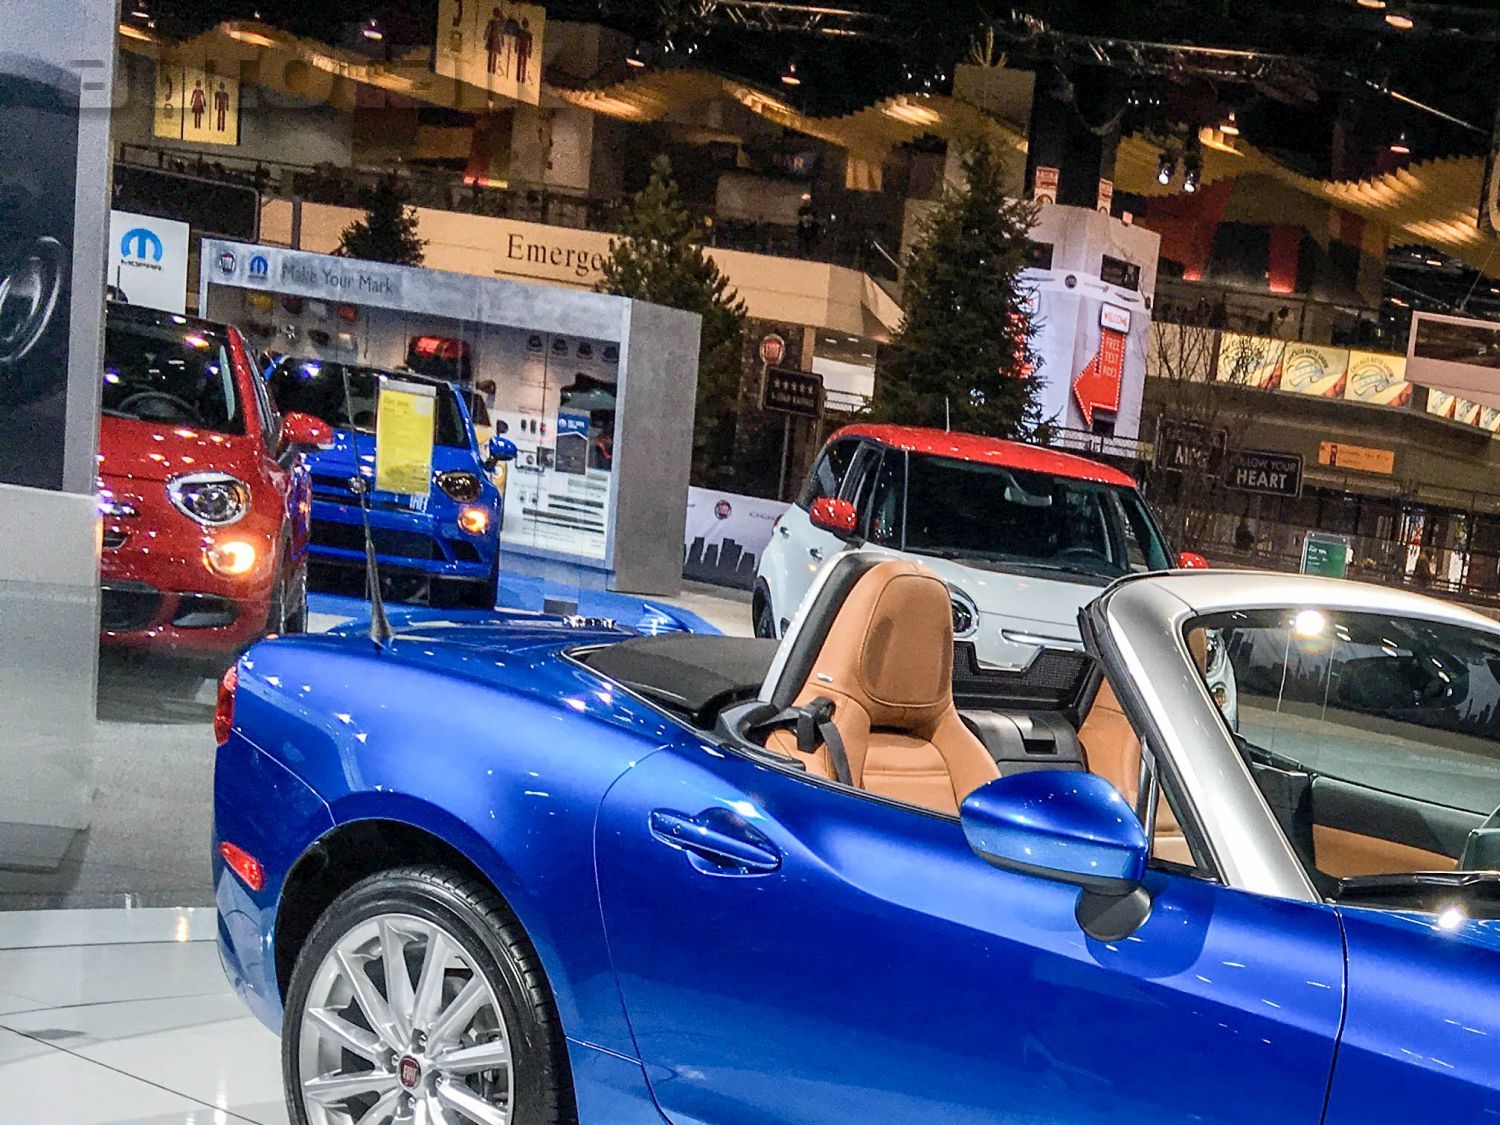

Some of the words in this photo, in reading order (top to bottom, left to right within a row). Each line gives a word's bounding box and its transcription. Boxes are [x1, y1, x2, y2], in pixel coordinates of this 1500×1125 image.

[507, 232, 608, 277] Emerge
[322, 268, 354, 292] Your
[359, 273, 393, 294] Mark
[1236, 468, 1288, 490] HEART
